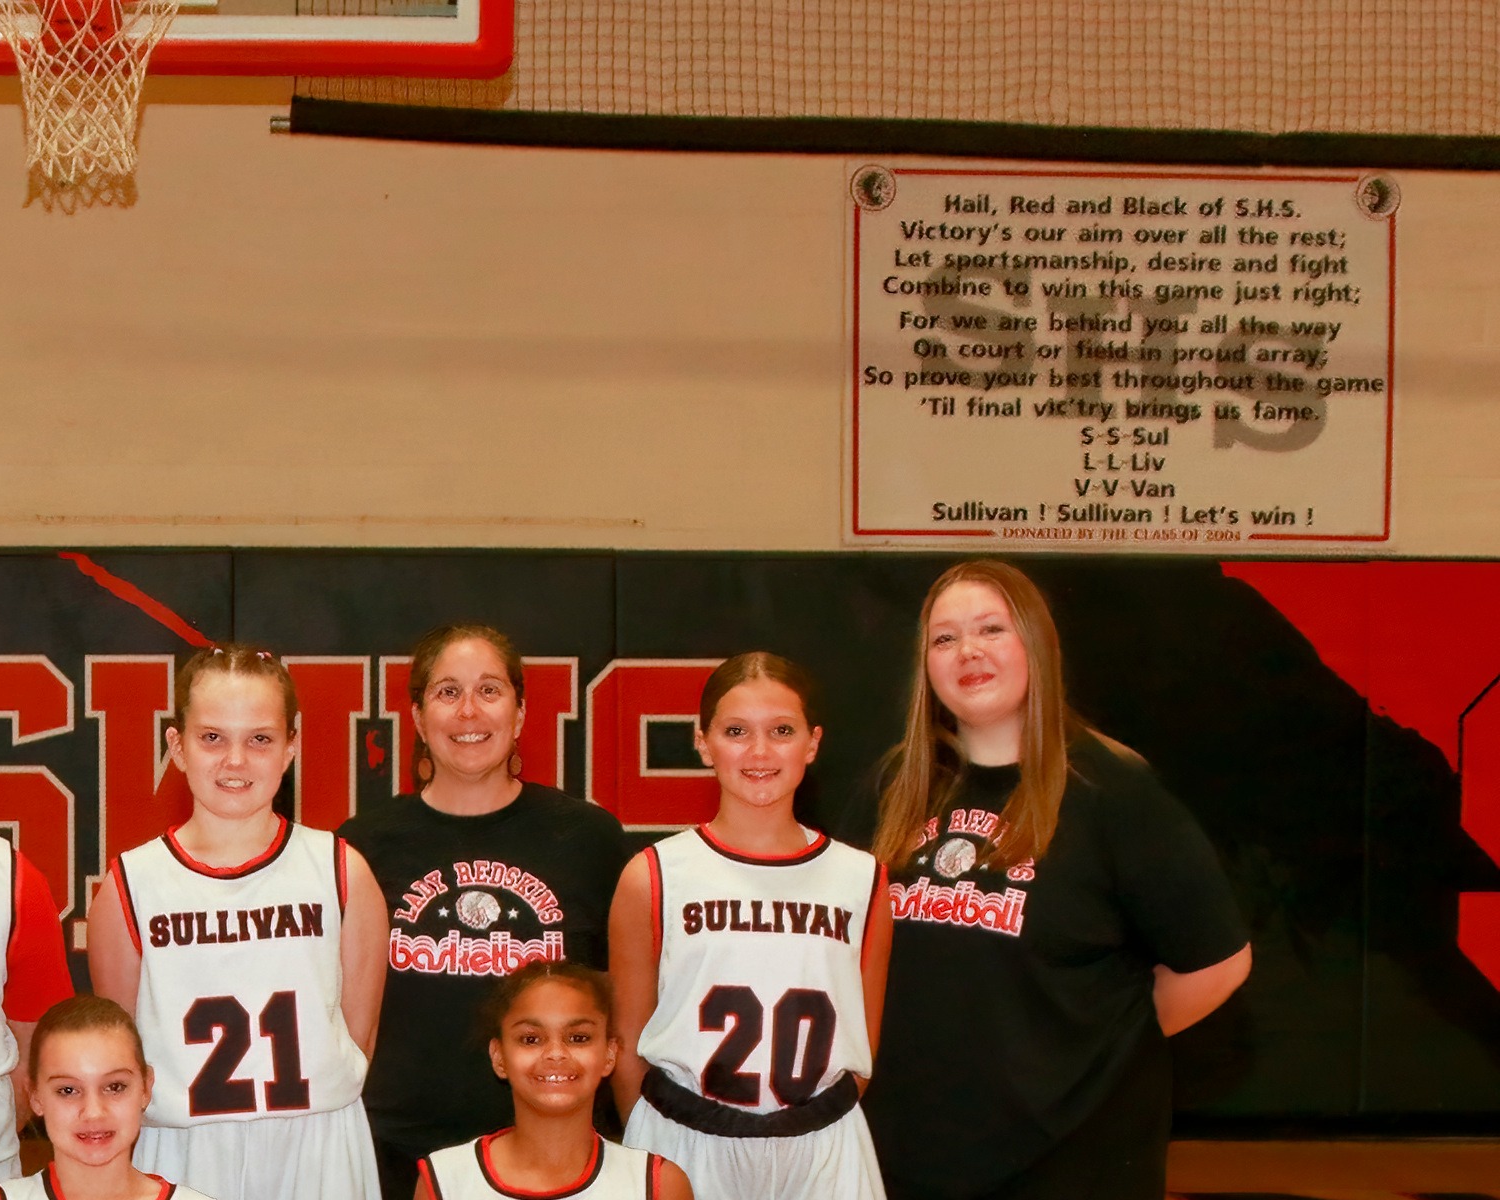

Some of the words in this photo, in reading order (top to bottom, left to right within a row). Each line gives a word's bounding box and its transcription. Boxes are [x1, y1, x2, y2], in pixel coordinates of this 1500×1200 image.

[944, 193, 999, 216] Hail,
[1009, 195, 1055, 214] Red
[1066, 196, 1112, 215] and
[1122, 196, 1188, 216] Black
[1199, 197, 1225, 216] of
[1235, 198, 1302, 218] S.H.S.
[900, 220, 1013, 246] Victory's
[1024, 226, 1067, 242] our
[1078, 223, 1123, 243] aim
[1134, 228, 1189, 244] over
[1200, 224, 1227, 244] all
[1237, 226, 1279, 245] the
[1289, 228, 1347, 249] rest;
[894, 248, 933, 267] Let
[944, 250, 1137, 275] sportsmanship,
[1147, 251, 1222, 272] desire
[1233, 254, 1278, 273] and
[1289, 253, 1348, 278] fight
[882, 276, 993, 296] Combine
[1003, 278, 1030, 296] to
[1041, 277, 1088, 298] win
[1099, 279, 1144, 298] this
[1154, 283, 1224, 305] game
[1234, 281, 1282, 306] just
[1293, 281, 1361, 307] right;
[899, 311, 940, 330] For
[951, 315, 988, 330] we
[999, 316, 1038, 331] are
[1049, 312, 1132, 332] behind
[1145, 318, 1189, 338] you
[1200, 314, 1228, 334] all
[1239, 315, 1280, 335] the
[1291, 320, 1342, 341] way
[913, 338, 947, 358] On
[958, 341, 1025, 359] court
[1037, 344, 1062, 359] or
[1076, 339, 1129, 360] field
[1140, 339, 1162, 361] in
[1172, 342, 1247, 364] proud
[1256, 348, 1329, 370] array;
[864, 365, 894, 386] So
[904, 370, 971, 391] prove
[984, 371, 1038, 391] your
[1049, 367, 1102, 388] best
[1111, 370, 1255, 394] throughout
[1266, 371, 1305, 392] the
[1317, 376, 1385, 396] game
[920, 397, 955, 416] 'Til
[966, 397, 1022, 417] final
[1033, 398, 1114, 423] vic'try
[1125, 399, 1202, 423] brings
[1214, 404, 1241, 420] us
[1253, 400, 1320, 421] fame.
[931, 501, 1029, 522] Sullivan
[1057, 503, 1153, 523] Sullivan
[1180, 505, 1240, 525] Let's
[1251, 506, 1296, 525] win
[1002, 527, 1073, 539] DONATED
[1077, 527, 1095, 540] BY
[1102, 528, 1127, 540] THE
[1133, 529, 1178, 541] CLASS
[393, 869, 449, 923] LADY
[453, 860, 564, 925] REDSKINS
[149, 903, 324, 949] SULLIVAN
[682, 899, 853, 945] SULLIVAN
[184, 990, 311, 1118] 21
[699, 984, 838, 1107] 20
